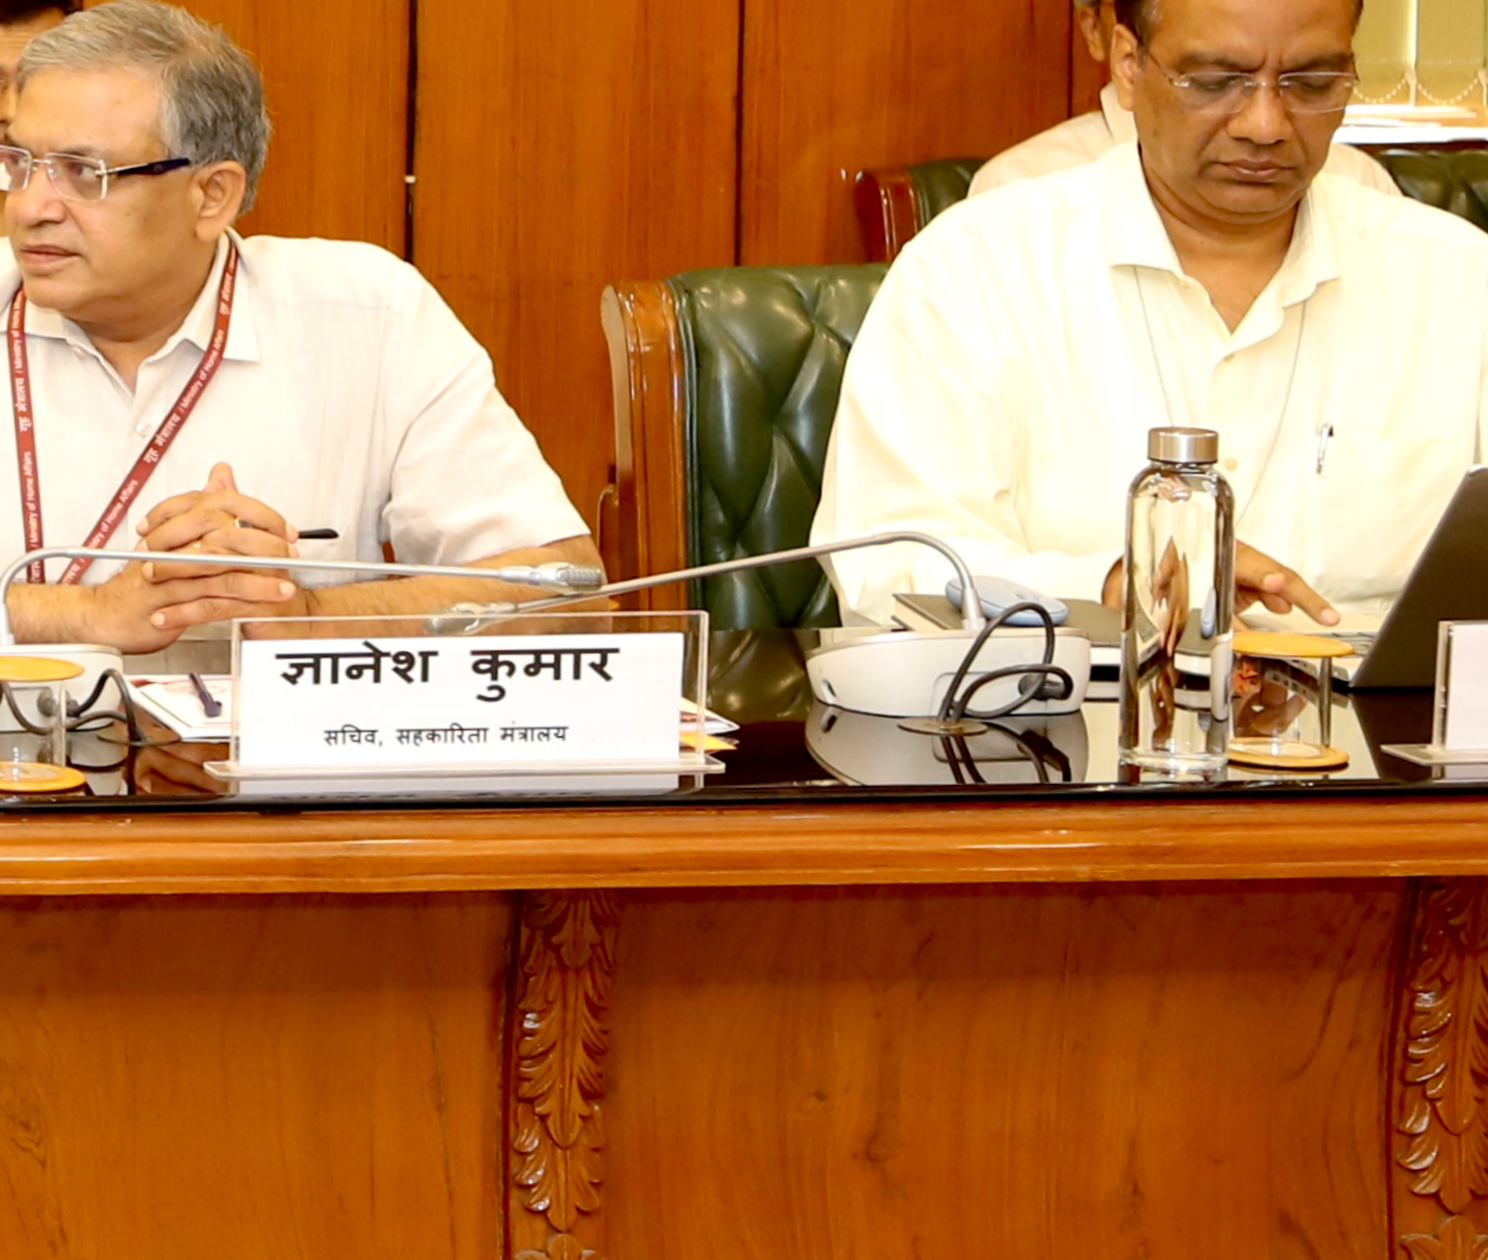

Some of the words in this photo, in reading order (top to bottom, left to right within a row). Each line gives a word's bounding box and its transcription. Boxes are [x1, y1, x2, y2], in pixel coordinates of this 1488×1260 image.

[23, 451, 34, 476] Affairs
[25, 478, 35, 501] Home
[106, 502, 123, 524] Home
[119, 479, 139, 504] Affairs
[27, 512, 39, 543] Ministry
[275, 641, 439, 686] ज्ञानेश
[471, 647, 621, 702] कुमार
[324, 724, 385, 748] सचिव,
[396, 722, 489, 746] सहकारिता
[500, 721, 570, 742] मंत्रालय
